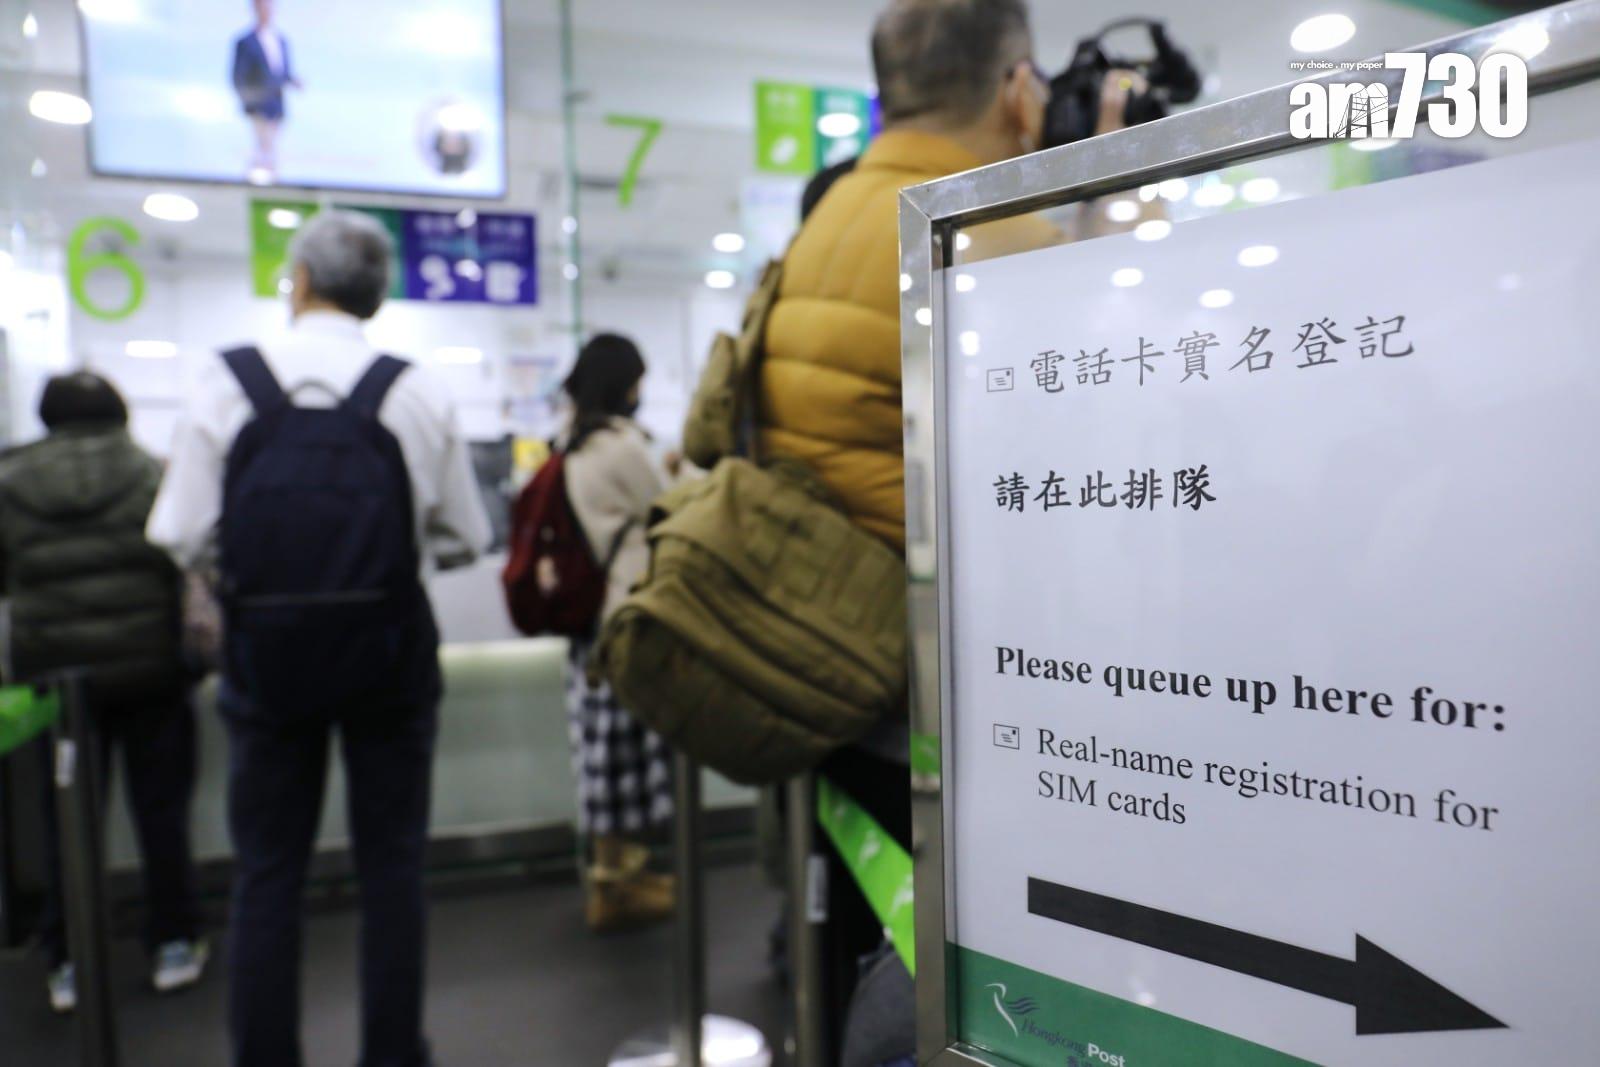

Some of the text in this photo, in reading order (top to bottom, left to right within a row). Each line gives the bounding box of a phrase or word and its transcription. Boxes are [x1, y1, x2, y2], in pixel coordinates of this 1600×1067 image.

[602, 113, 662, 209] 7
[66, 215, 146, 323] 6
[1029, 315, 1415, 394] 電話卡實名登記
[992, 463, 1218, 513] 請在此排隊
[995, 645, 1506, 732] Please queue up here for:
[1036, 727, 1500, 832] Real-name registration for
[1037, 770, 1187, 825] SIM cards
